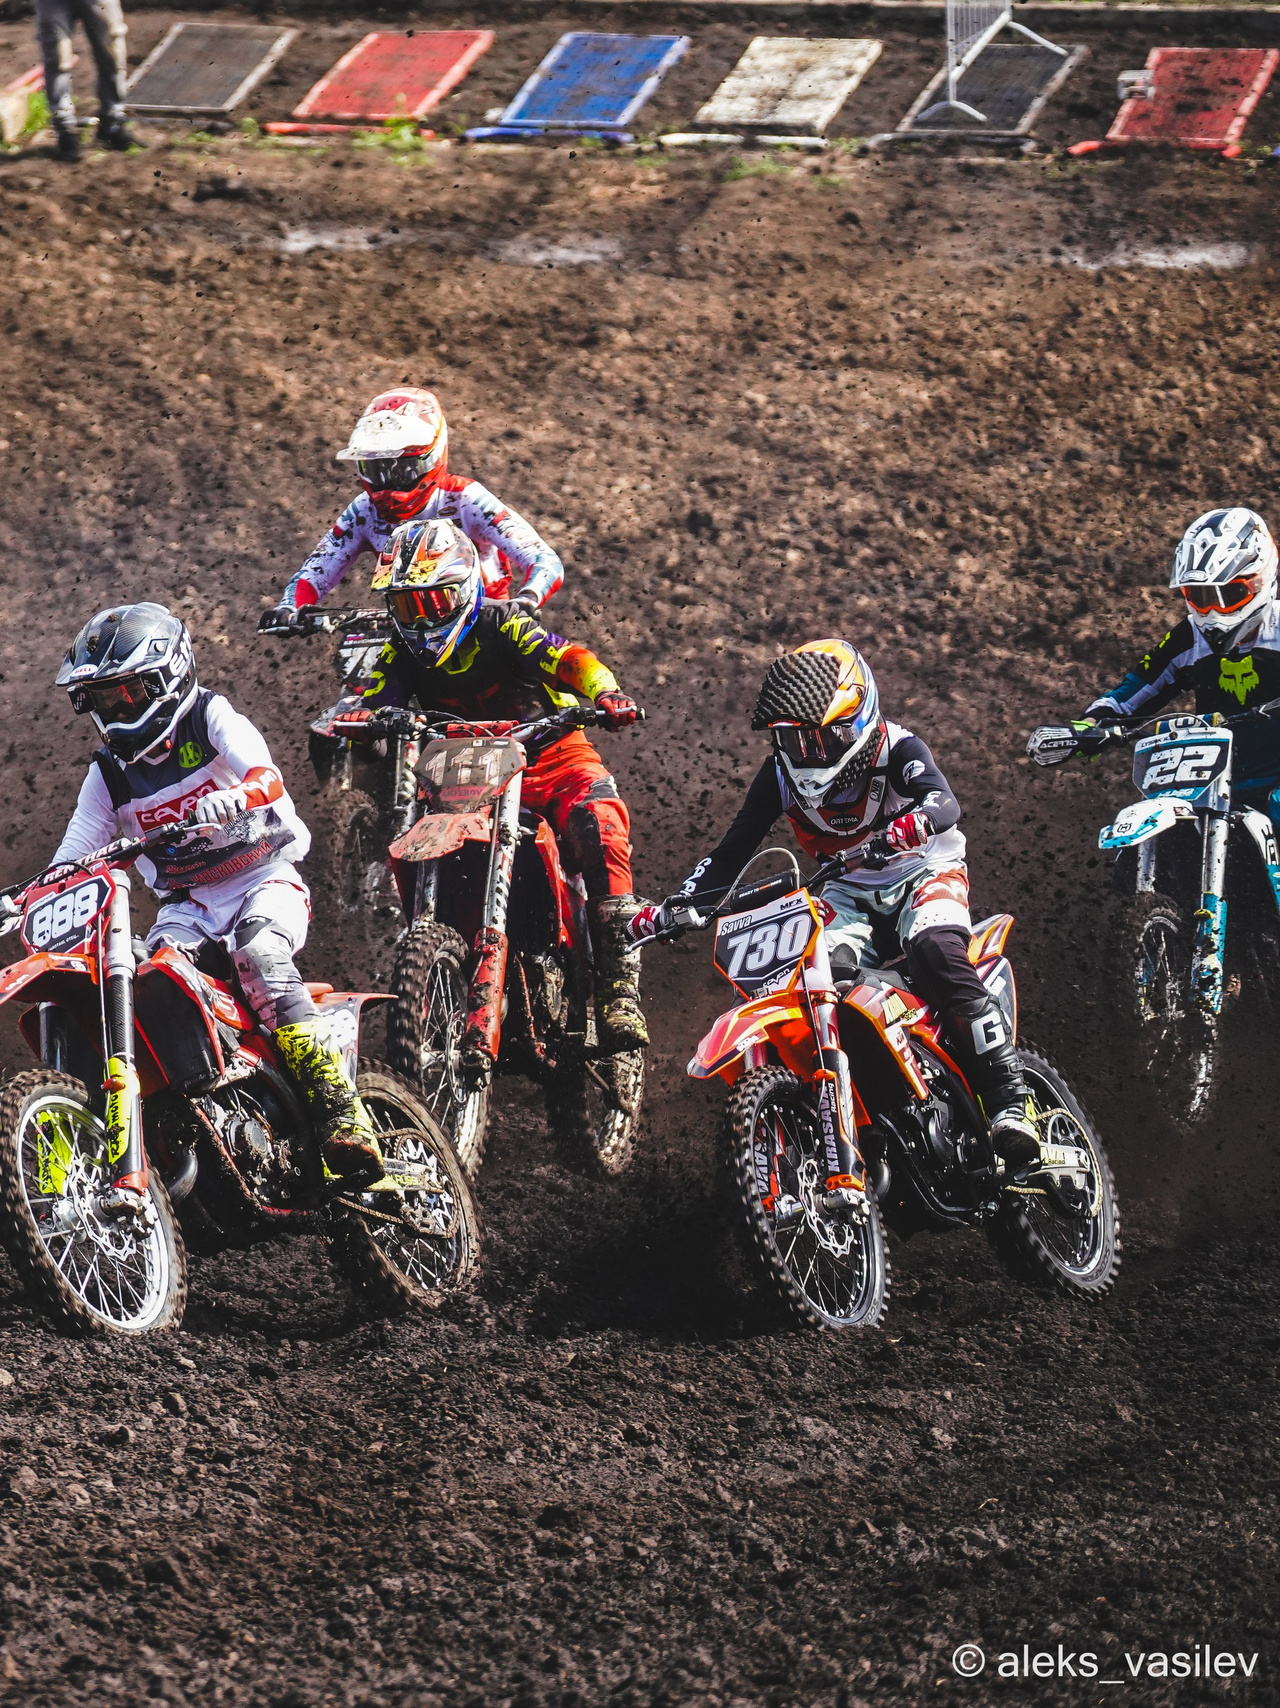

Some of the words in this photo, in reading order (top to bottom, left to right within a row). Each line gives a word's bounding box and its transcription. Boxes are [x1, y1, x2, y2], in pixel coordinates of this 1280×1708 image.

[425, 747, 503, 786] 111
[1141, 745, 1221, 790] 22
[830, 816, 859, 826] ORTEMA
[32, 882, 100, 948] 888
[780, 897, 803, 911] MFX
[721, 915, 752, 936] Savva
[727, 913, 811, 980] 730
[827, 1081, 838, 1114] Racing
